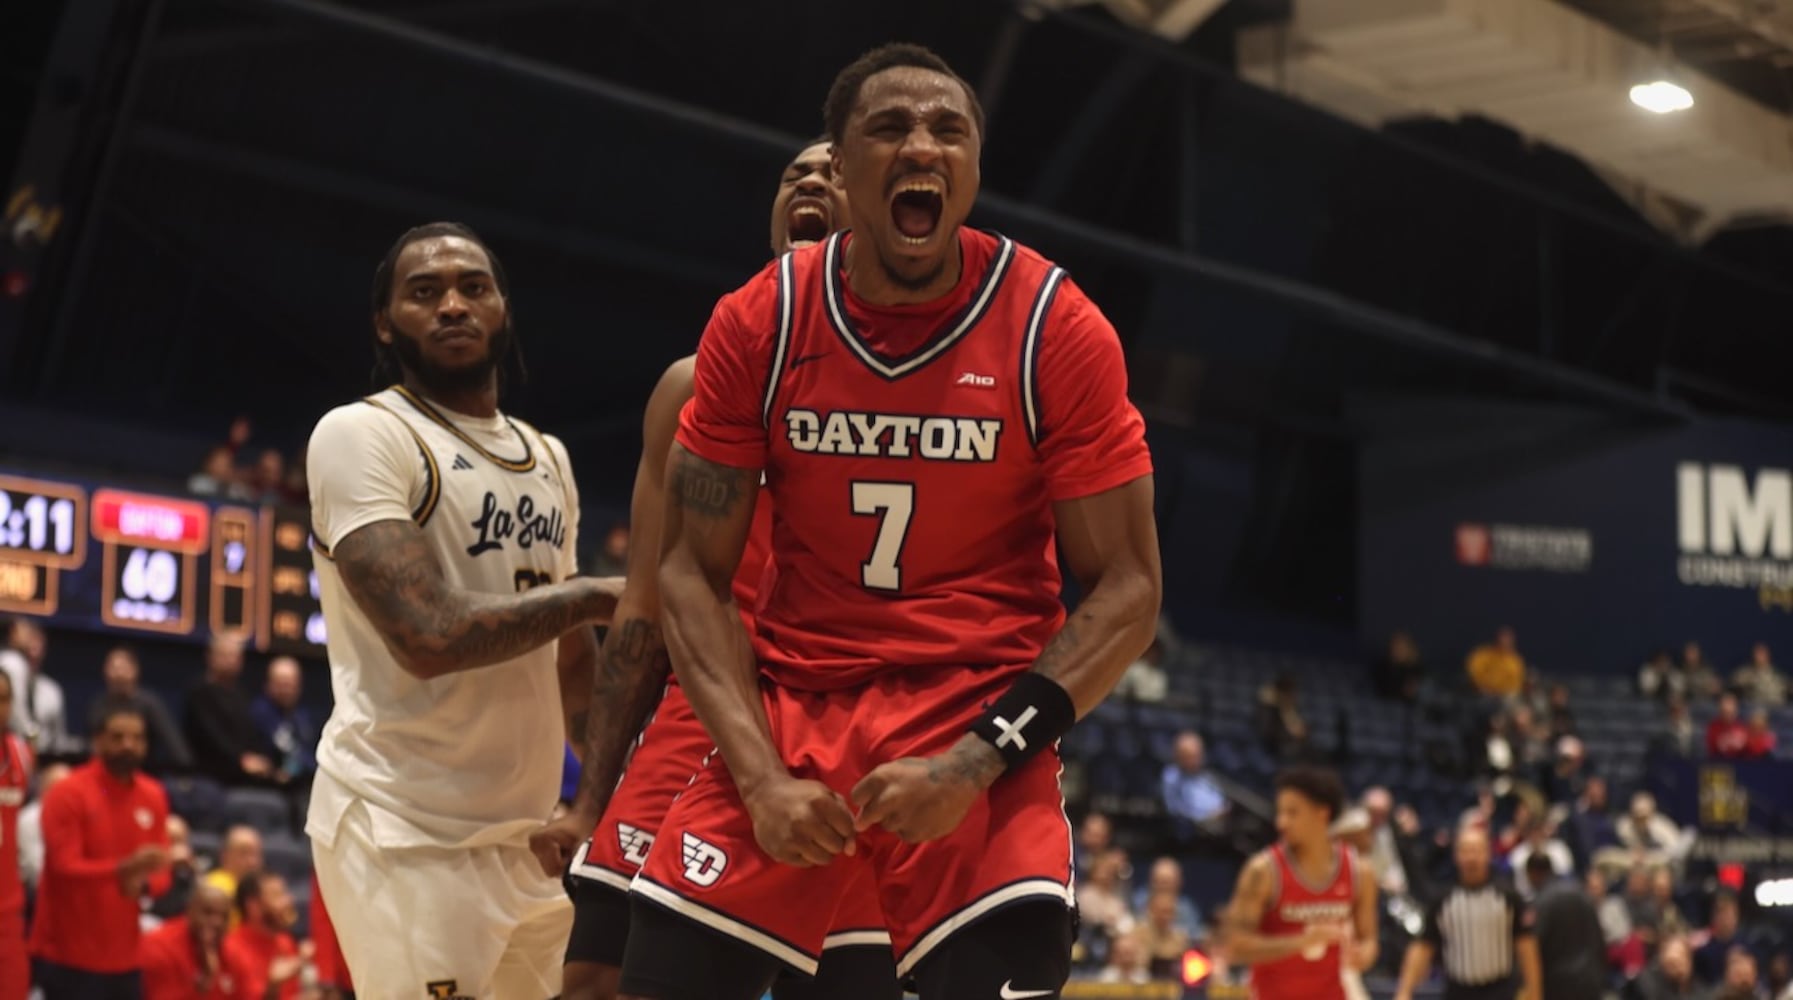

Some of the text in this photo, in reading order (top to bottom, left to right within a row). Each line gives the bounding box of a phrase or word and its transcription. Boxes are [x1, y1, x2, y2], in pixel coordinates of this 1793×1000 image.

[957, 372, 995, 386] A10
[786, 409, 1002, 463] DAYTON
[467, 491, 515, 557] La
[850, 479, 915, 591] 7
[121, 547, 178, 603] 60
